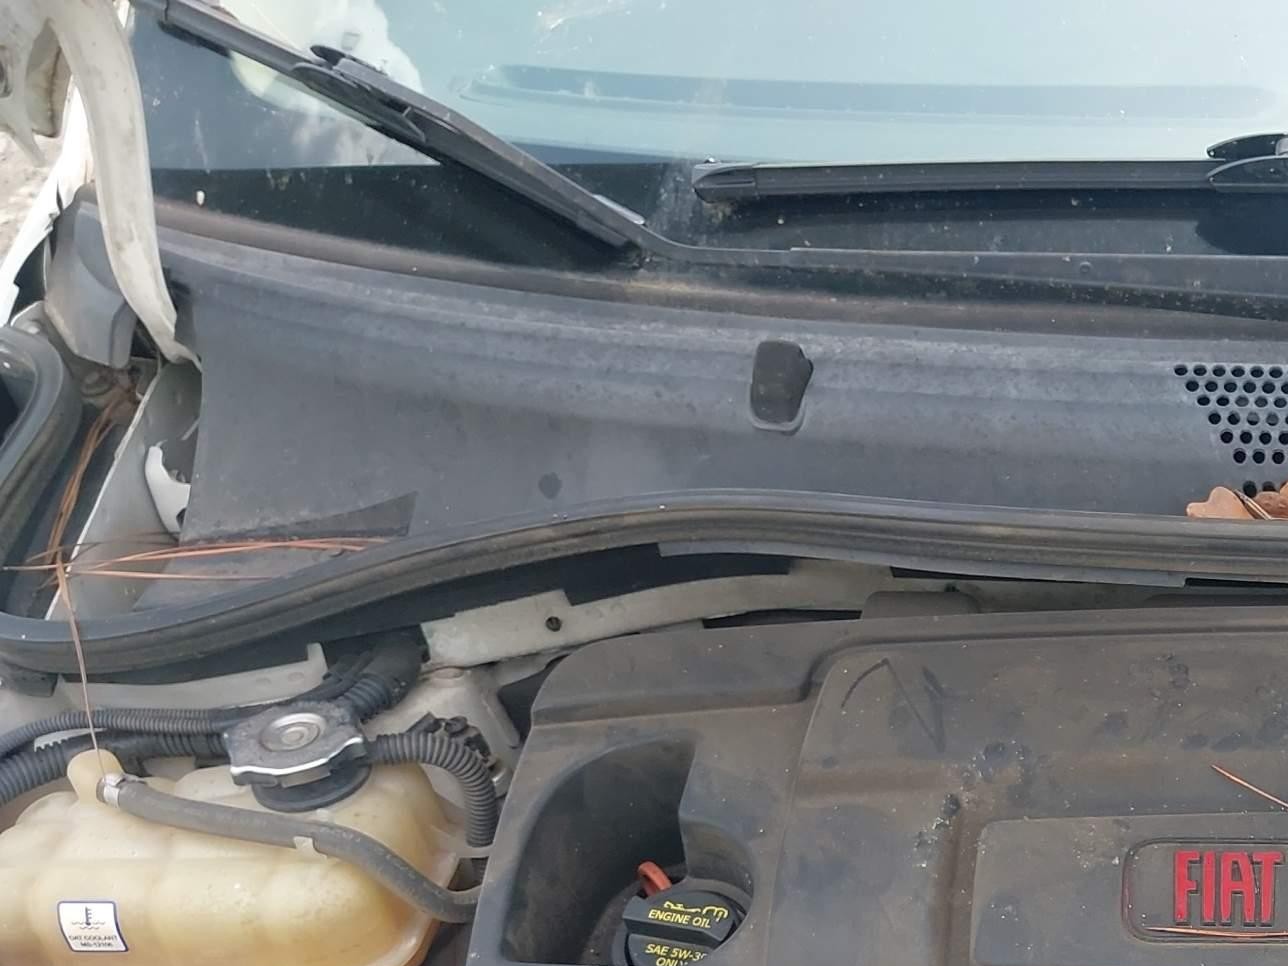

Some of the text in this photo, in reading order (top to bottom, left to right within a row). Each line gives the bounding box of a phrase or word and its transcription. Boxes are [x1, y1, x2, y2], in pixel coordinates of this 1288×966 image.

[1173, 850, 1283, 928] FIAT
[648, 909, 712, 928] ENGINE OIL
[645, 944, 669, 956] SAE
